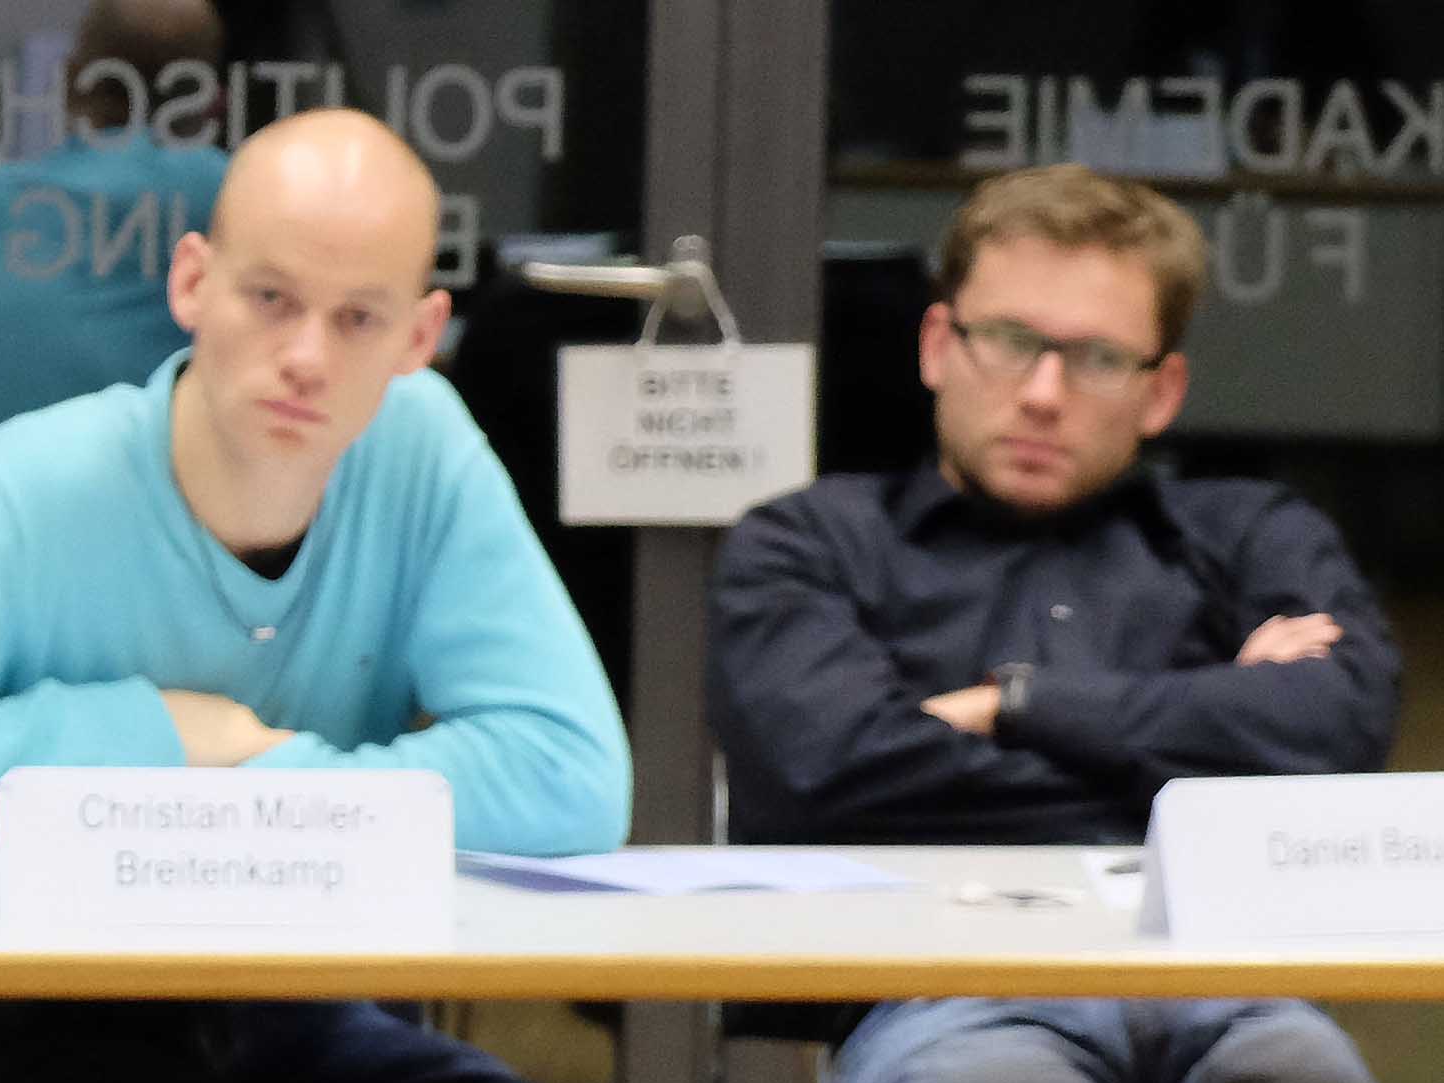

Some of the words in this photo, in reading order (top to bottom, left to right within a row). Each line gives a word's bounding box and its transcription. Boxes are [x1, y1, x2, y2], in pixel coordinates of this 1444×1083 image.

[638, 369, 734, 397] BITTE
[637, 407, 735, 434] NICHT
[77, 792, 239, 831] Christian
[1267, 830, 1368, 866] Daniel
[114, 849, 344, 895] Breitenkamp
